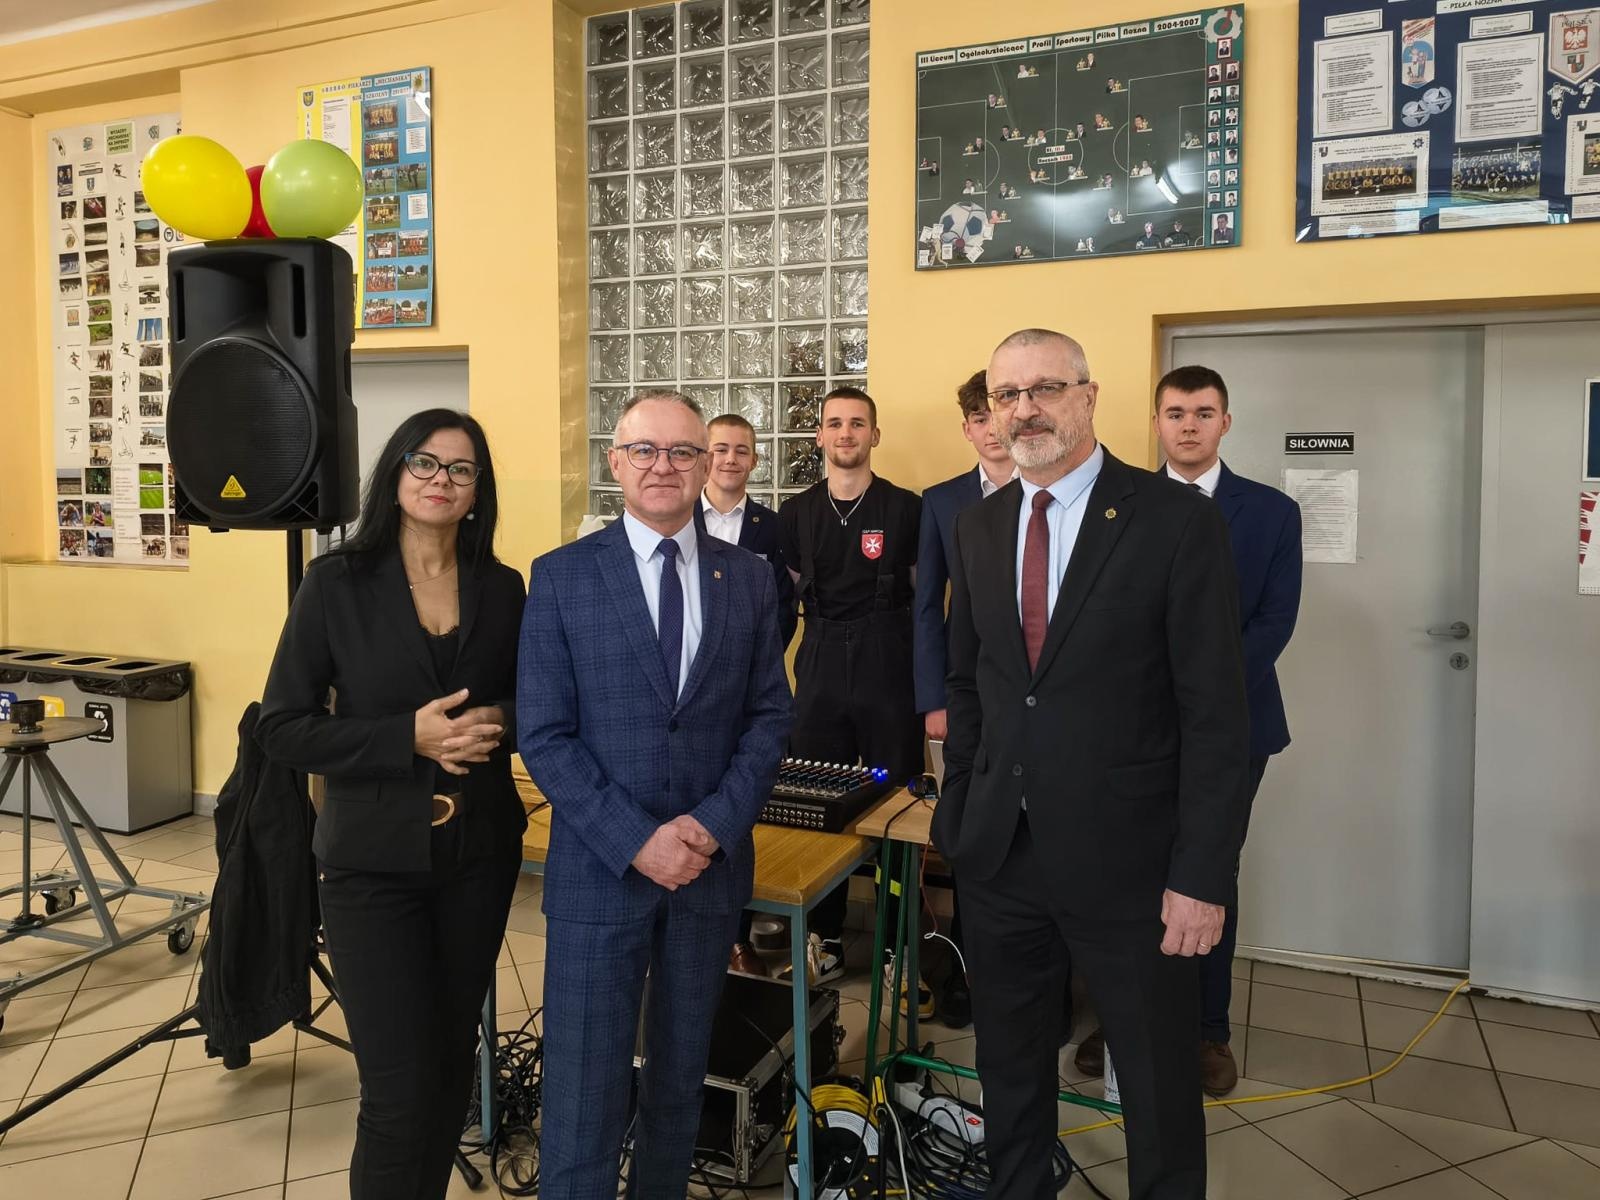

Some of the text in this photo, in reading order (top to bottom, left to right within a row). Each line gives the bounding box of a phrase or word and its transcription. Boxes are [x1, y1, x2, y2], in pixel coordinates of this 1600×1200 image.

[930, 54, 954, 63] Liceum
[1032, 39, 1052, 49] Profil
[1056, 35, 1090, 46] Sportowy
[1157, 18, 1200, 31] 2004-2007
[1289, 438, 1350, 449] SIŁOWNIA
